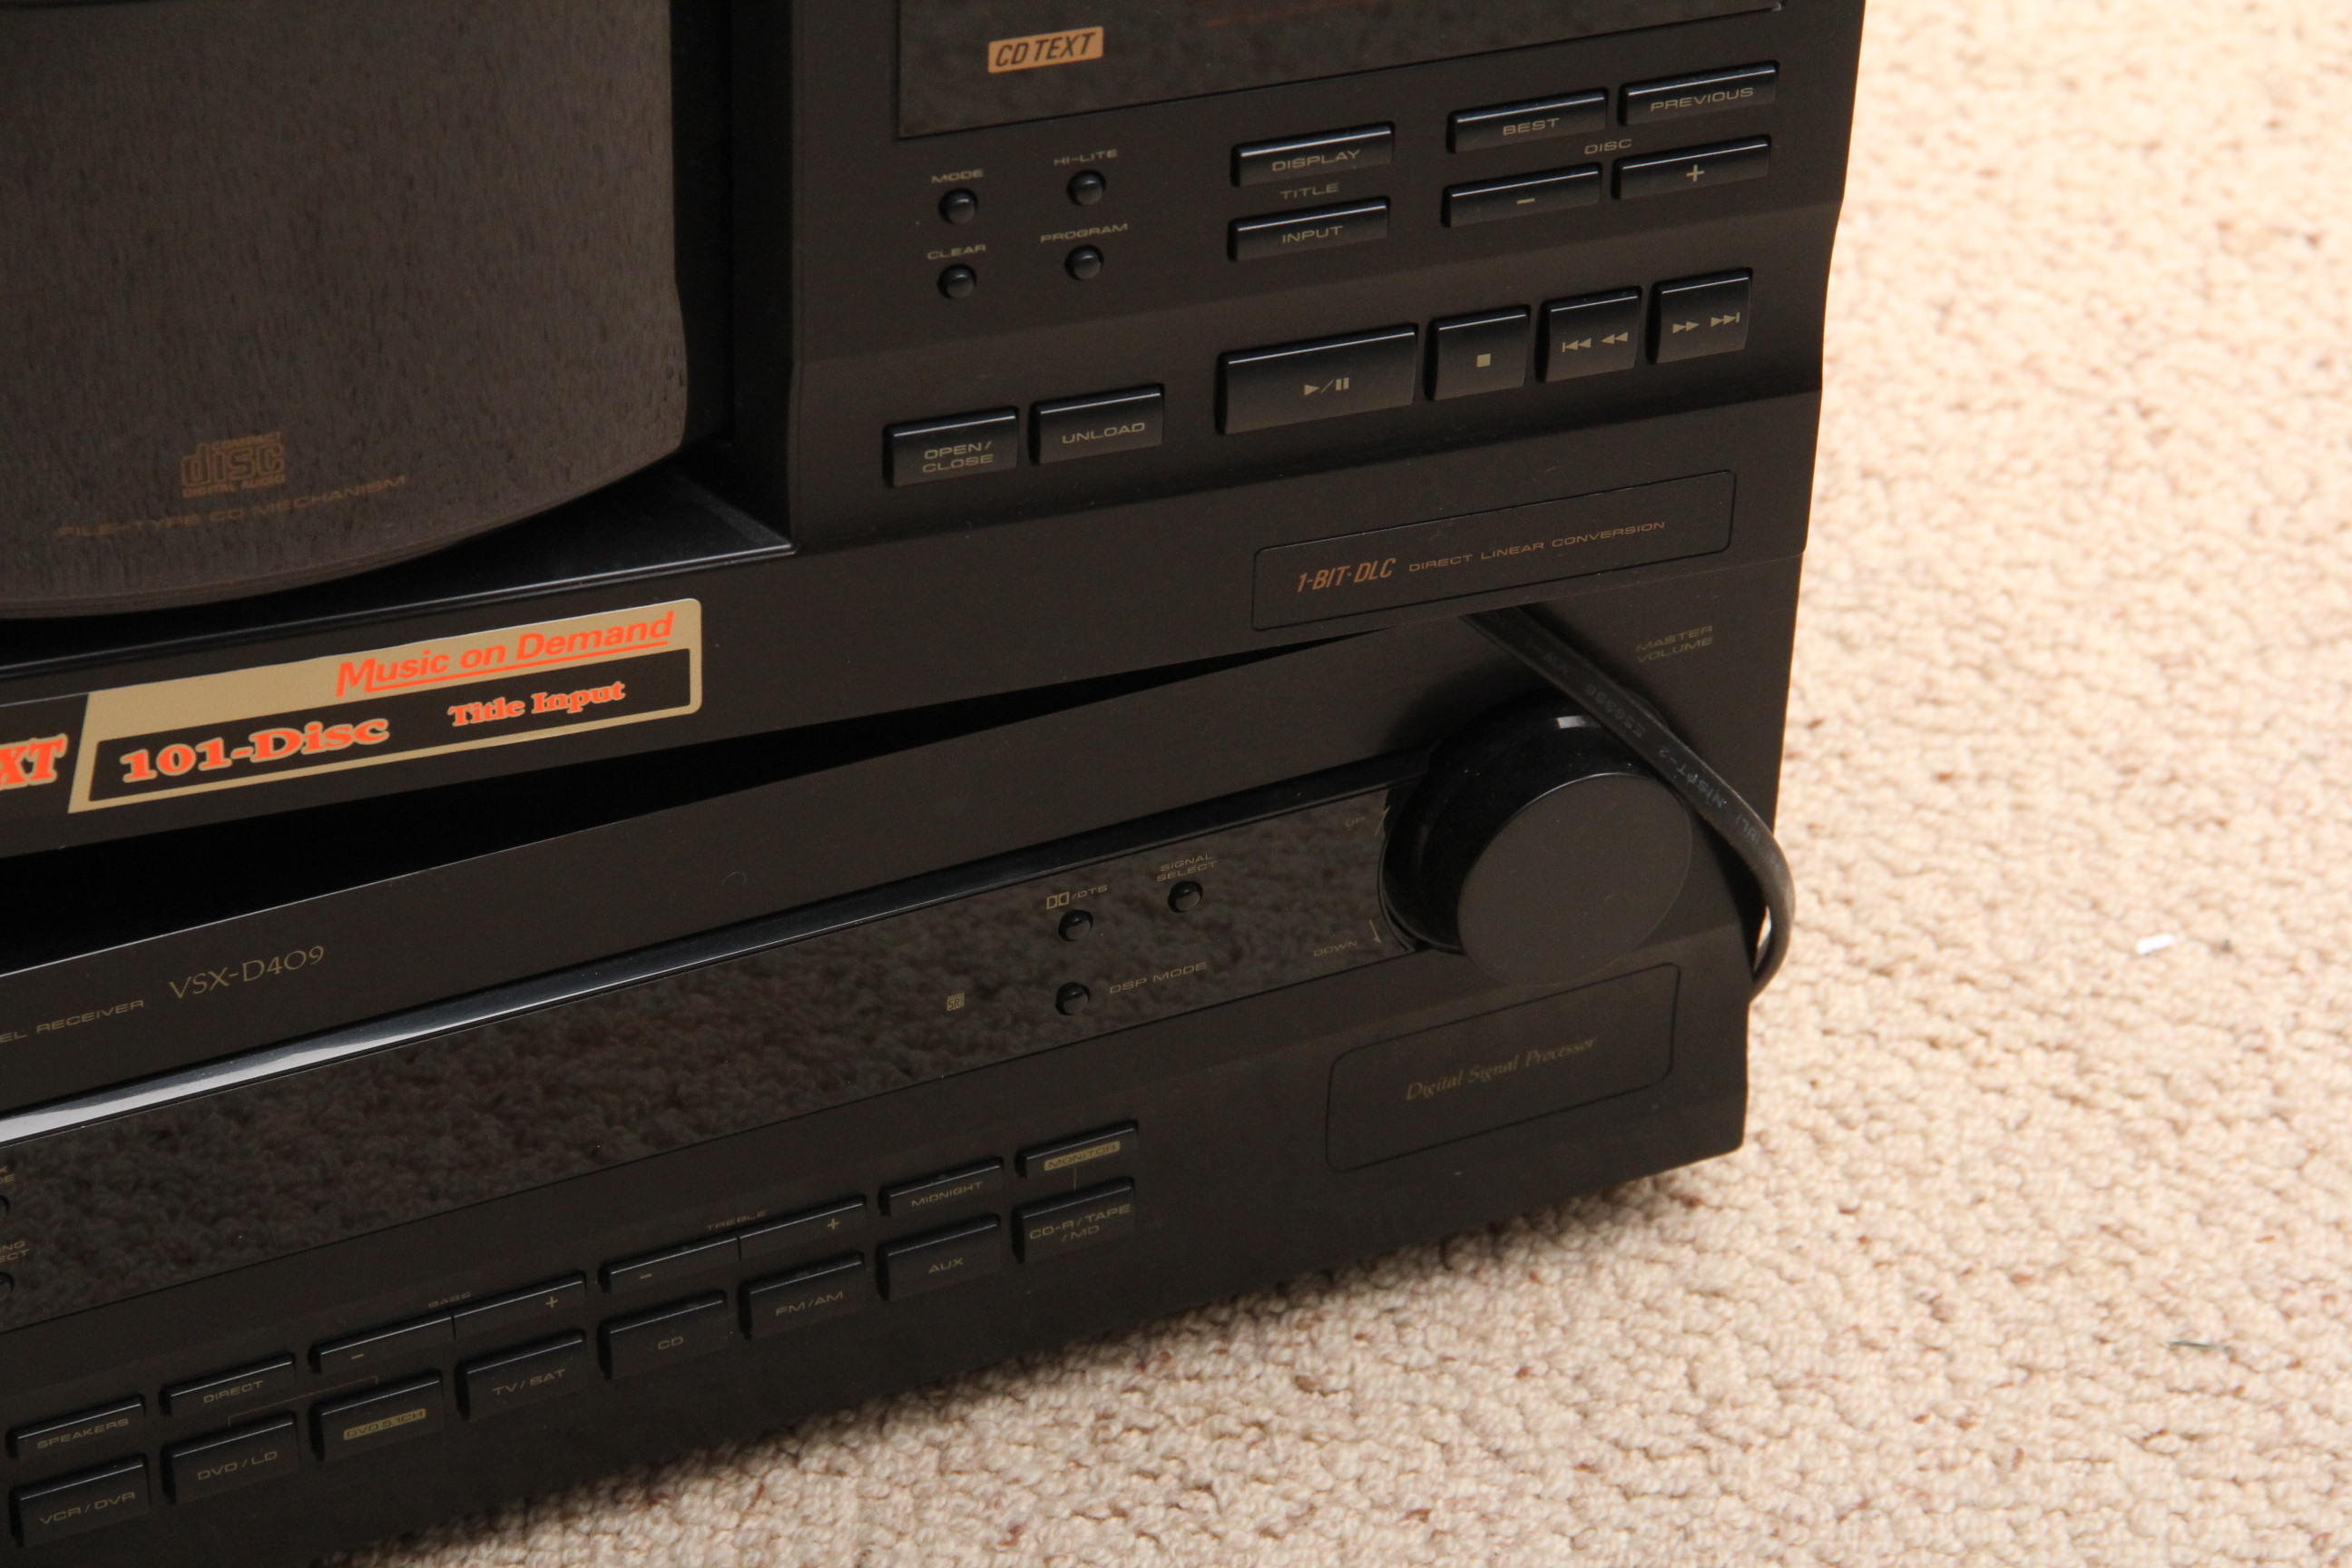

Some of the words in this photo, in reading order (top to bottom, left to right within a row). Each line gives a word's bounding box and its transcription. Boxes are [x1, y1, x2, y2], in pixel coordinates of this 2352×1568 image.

[1649, 87, 1755, 112] PREVIOUS
[1502, 117, 1561, 136] BEST
[1054, 149, 1119, 167] HI-LITE
[1584, 138, 1632, 155] DISC
[1271, 150, 1362, 173] DISPLAY
[931, 169, 985, 184] MODE
[1279, 182, 1341, 201] TITLE
[1040, 223, 1129, 243] PROGRAM
[1281, 225, 1343, 244] INPUT
[926, 242, 987, 260] CLEAR
[1062, 421, 1146, 445] UNLOAD
[924, 440, 994, 460] OPEN/
[922, 454, 995, 474] CLOSE
[253, 475, 407, 514] MECHANISM
[1409, 554, 1474, 572] DIRECT
[1481, 543, 1544, 560] LINEAR
[1552, 521, 1666, 548] CONVERSION
[1635, 625, 1713, 652] MASTER
[1637, 637, 1713, 662] VOLUME
[336, 655, 450, 697] Music
[460, 647, 506, 670] on
[516, 611, 674, 662] Demand
[447, 697, 525, 727] Title
[532, 681, 626, 712] Input
[121, 719, 389, 782] 101-Disc
[1157, 861, 1218, 882] SELECT
[1160, 853, 1216, 873] SIGNAL
[1314, 939, 1357, 957] DOWN
[169, 945, 325, 999] VSX-D409
[1110, 977, 1148, 995] DSP
[1153, 961, 1209, 983] MODE
[36, 1000, 144, 1034] RECEIVER
[1406, 1070, 1463, 1102] Digital
[1467, 1054, 1520, 1081] Signal
[1525, 1037, 1597, 1067] Processor
[1046, 1144, 1117, 1169] MONITOR
[911, 1181, 984, 1207] MIDNIGHT
[705, 1210, 767, 1231] TREBLE
[927, 1257, 965, 1274] AUX
[427, 1291, 472, 1308] BASS
[775, 1291, 844, 1317] FM/AM
[657, 1335, 684, 1350] CD
[203, 1379, 263, 1404] DIRECT
[37, 1417, 130, 1449] SPEAKERS
